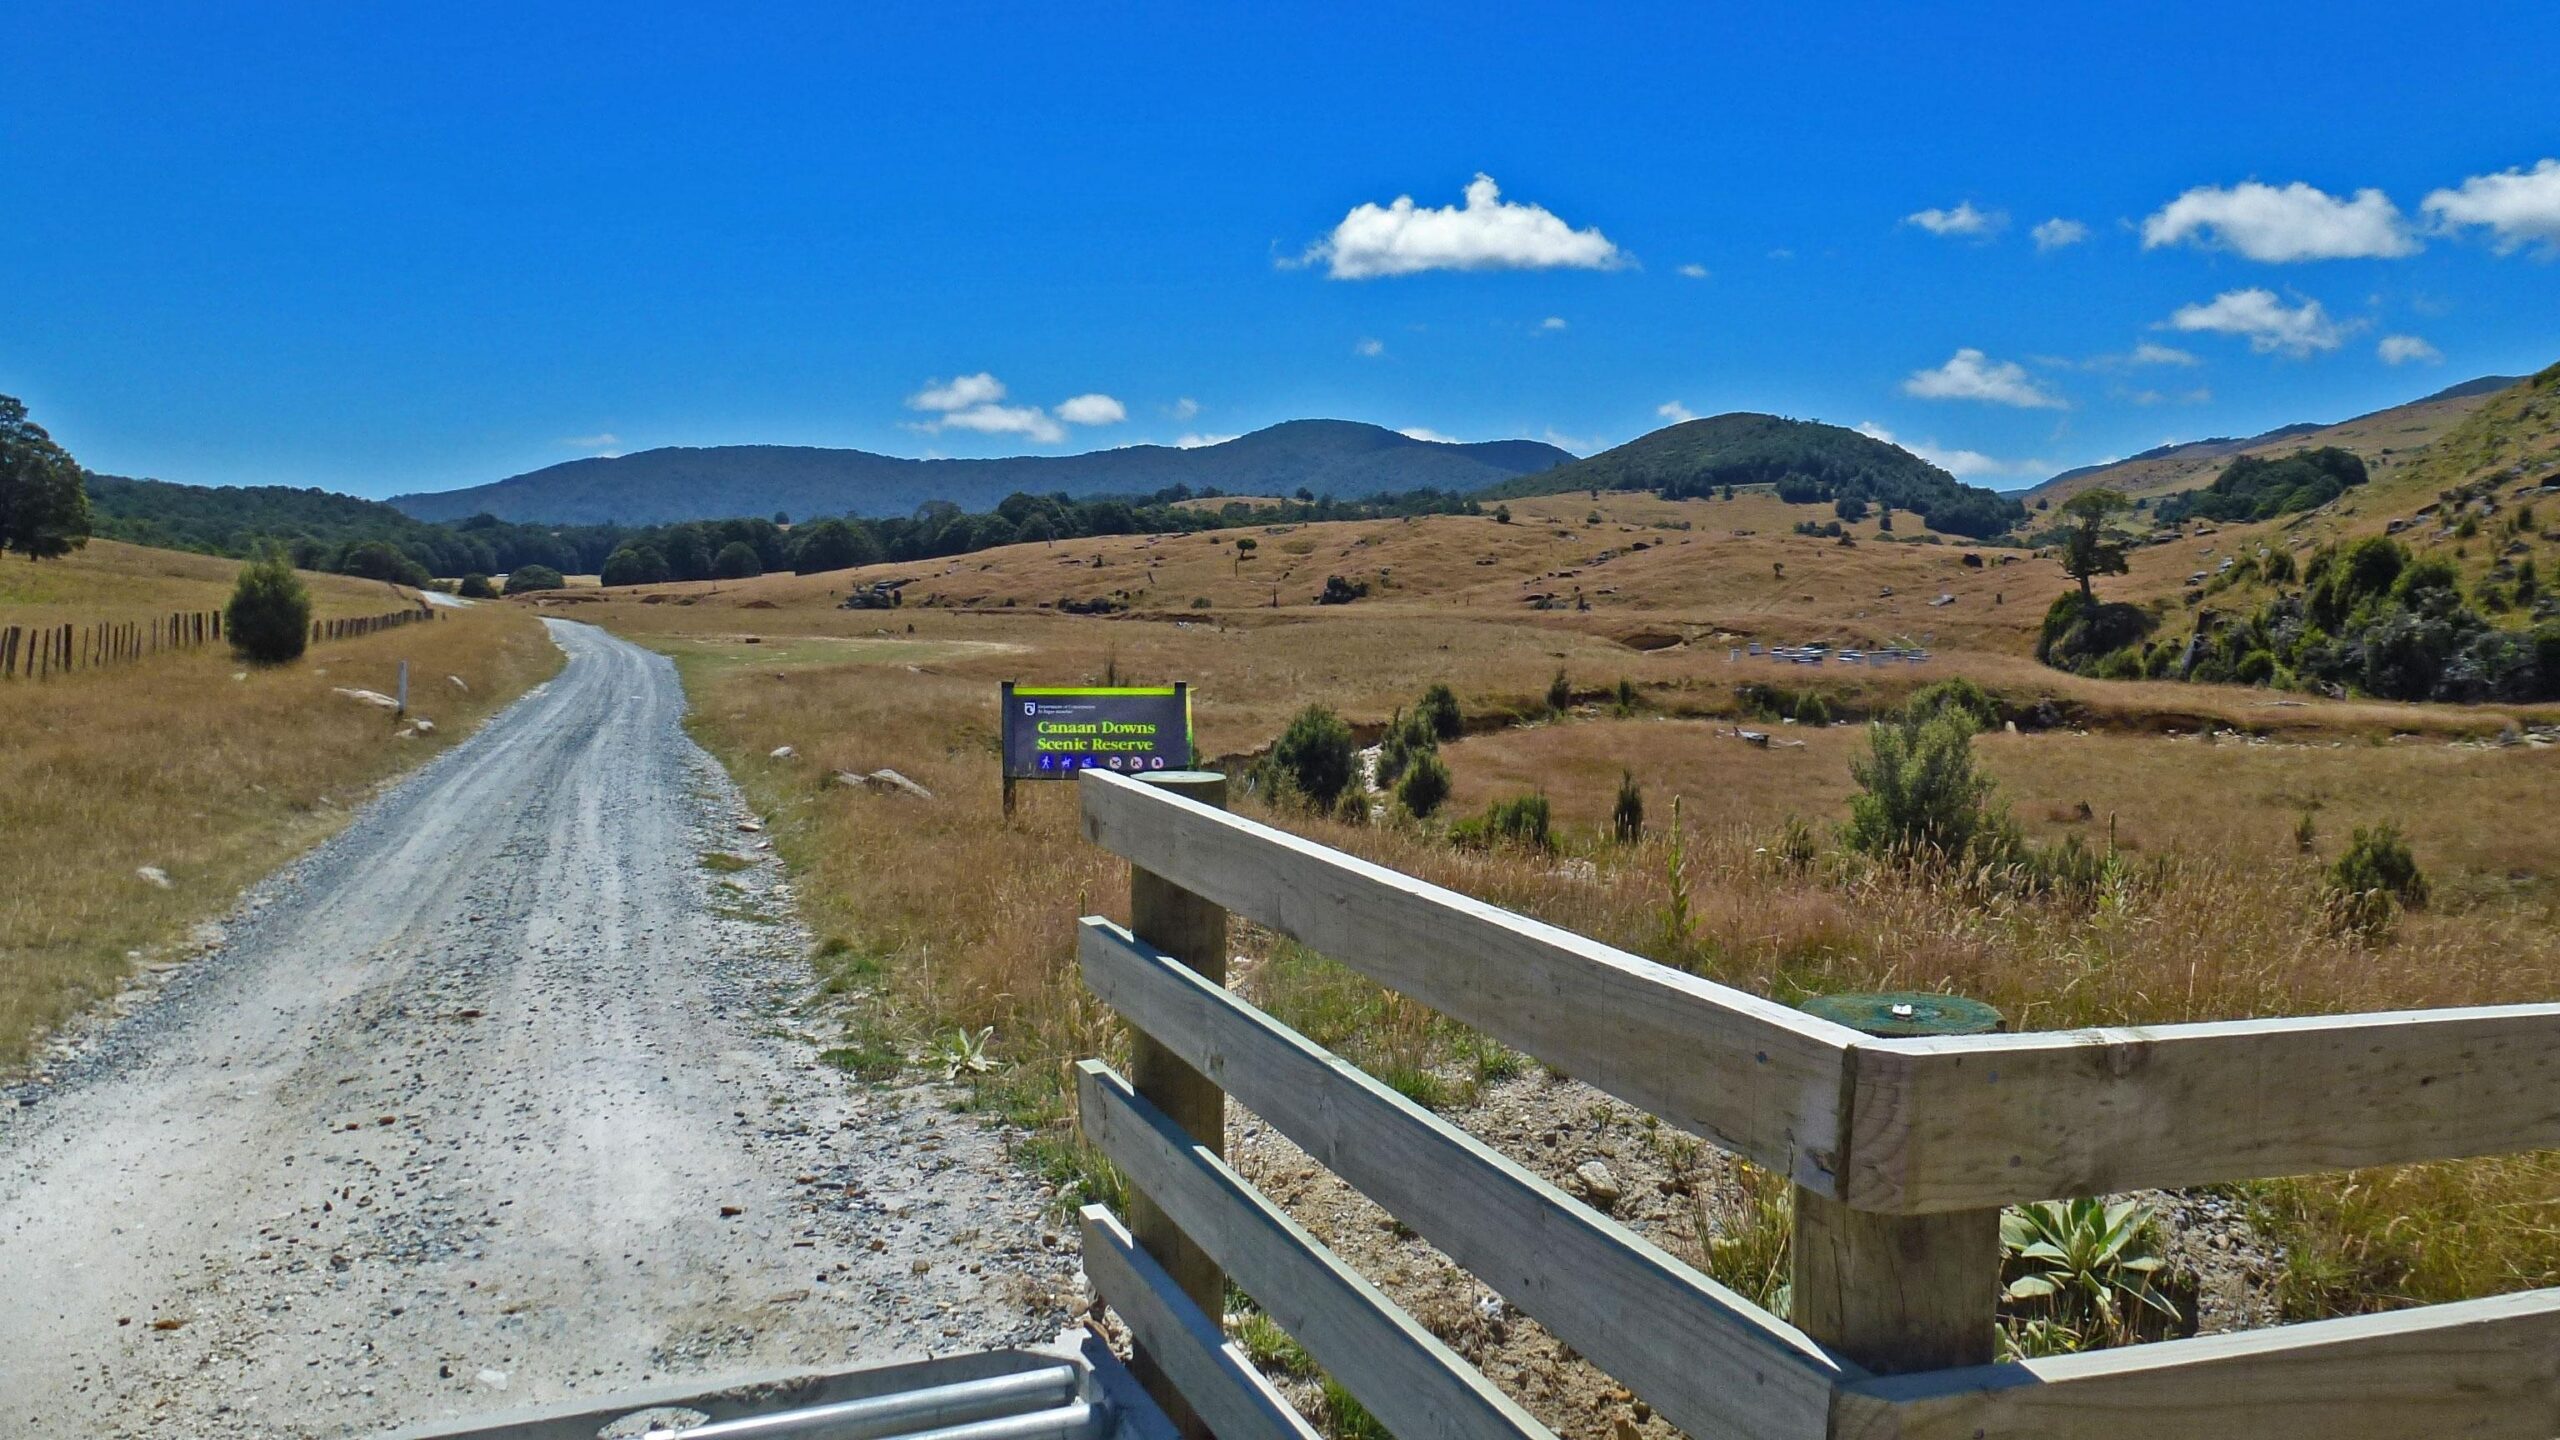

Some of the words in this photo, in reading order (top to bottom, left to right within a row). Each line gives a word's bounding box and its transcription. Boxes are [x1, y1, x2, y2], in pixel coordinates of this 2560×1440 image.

[1037, 721, 1097, 734] Canaan
[1101, 721, 1156, 734] Downs
[1037, 738, 1088, 751] Scenic
[1092, 738, 1153, 751] Reserve
